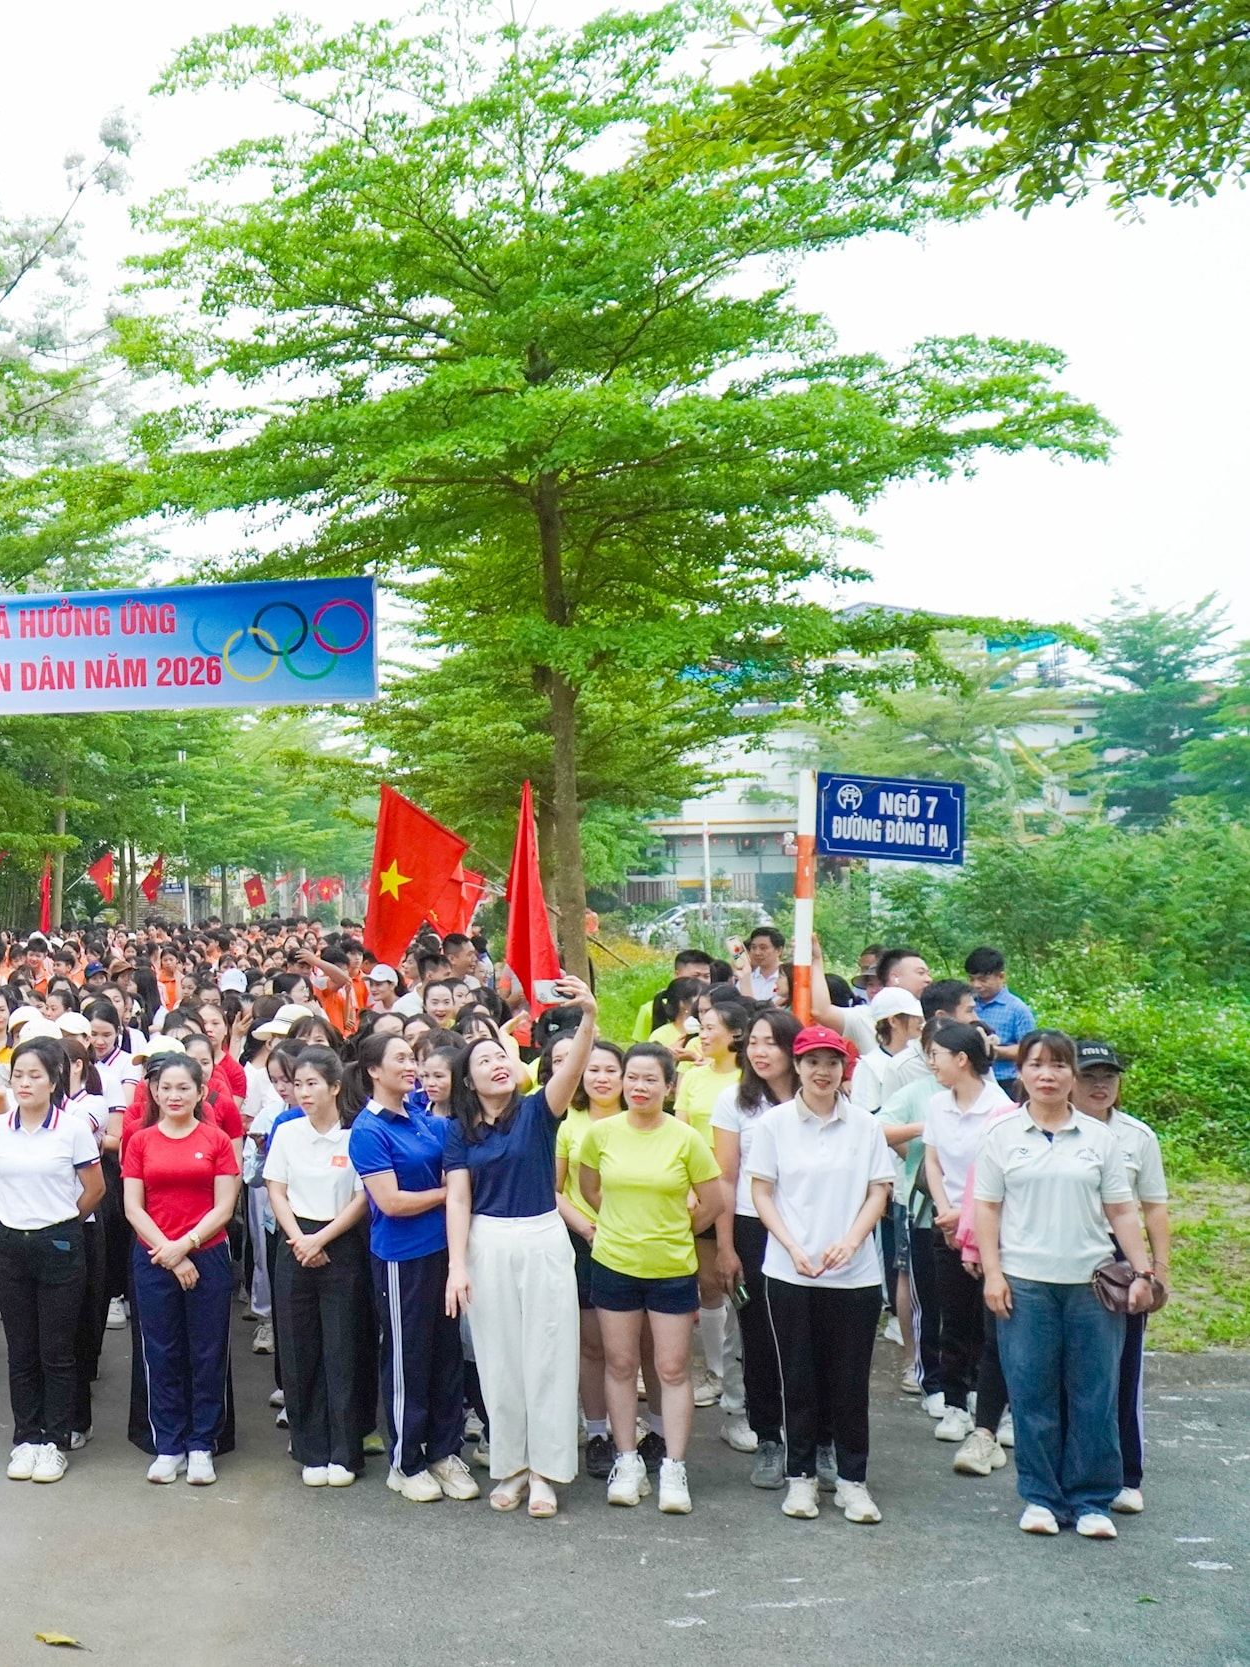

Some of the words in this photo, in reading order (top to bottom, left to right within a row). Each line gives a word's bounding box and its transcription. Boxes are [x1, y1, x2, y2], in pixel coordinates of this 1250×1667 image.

[19, 598, 111, 638] HƯỞNG
[120, 599, 176, 635] ỨNG
[20, 656, 74, 691] DÂN
[85, 652, 147, 689] NĂM
[156, 656, 222, 686] 2026
[879, 789, 920, 818] NGÕ
[926, 796, 938, 819] 7
[832, 812, 882, 842] ĐƯỜNG
[885, 817, 925, 846] ĐÔNG
[928, 824, 948, 852] HẠ
